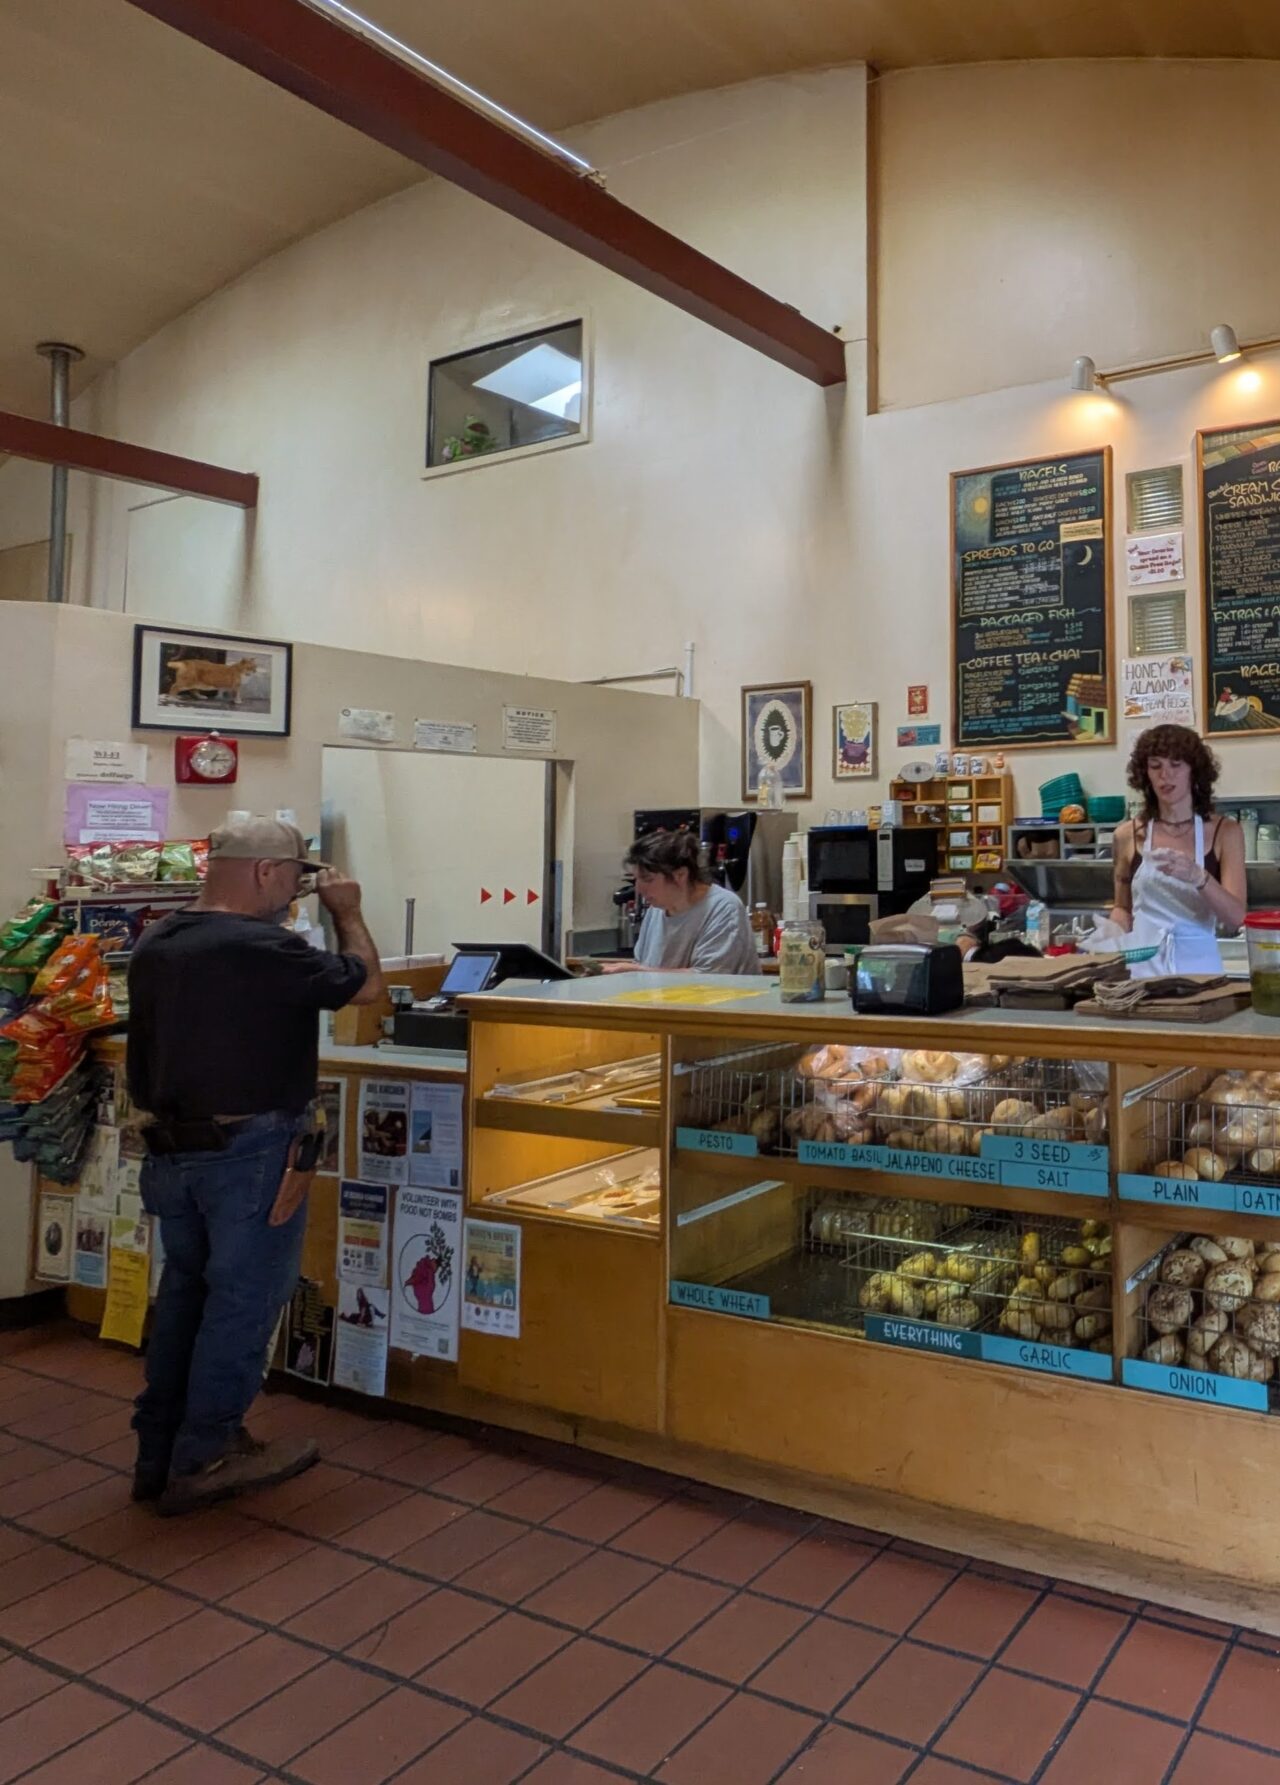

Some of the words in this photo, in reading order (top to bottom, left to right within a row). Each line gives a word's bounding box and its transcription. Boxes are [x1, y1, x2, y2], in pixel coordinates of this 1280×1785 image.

[1223, 481, 1269, 497] CREAM
[964, 545, 1017, 562] SPREADS
[1021, 543, 1036, 554] TO
[1038, 540, 1055, 552] GO
[1048, 608, 1075, 620] FISH
[1213, 607, 1263, 623] EXTRAS
[966, 654, 1013, 669] COFFEE
[1015, 652, 1040, 664] TEA
[1049, 648, 1080, 662] CHAI
[1125, 662, 1166, 680] HONEY
[1130, 679, 1176, 695] ALMOND
[700, 1134, 734, 1151] PESTO
[1015, 1142, 1024, 1158] 3
[1031, 1143, 1070, 1163] SEED
[805, 1144, 846, 1161] TOMATO
[852, 1148, 883, 1165] BASIL
[885, 1154, 943, 1174] JALAPENO
[948, 1161, 996, 1180] CHEESE
[1037, 1168, 1070, 1188] SALT
[1152, 1181, 1199, 1202] PLAIN
[677, 1286, 717, 1306] WHOLE
[721, 1291, 764, 1312] WHEAT
[883, 1321, 963, 1351] EVERYTHING
[1019, 1344, 1072, 1370] GARLIC
[1168, 1372, 1218, 1398] ONION
